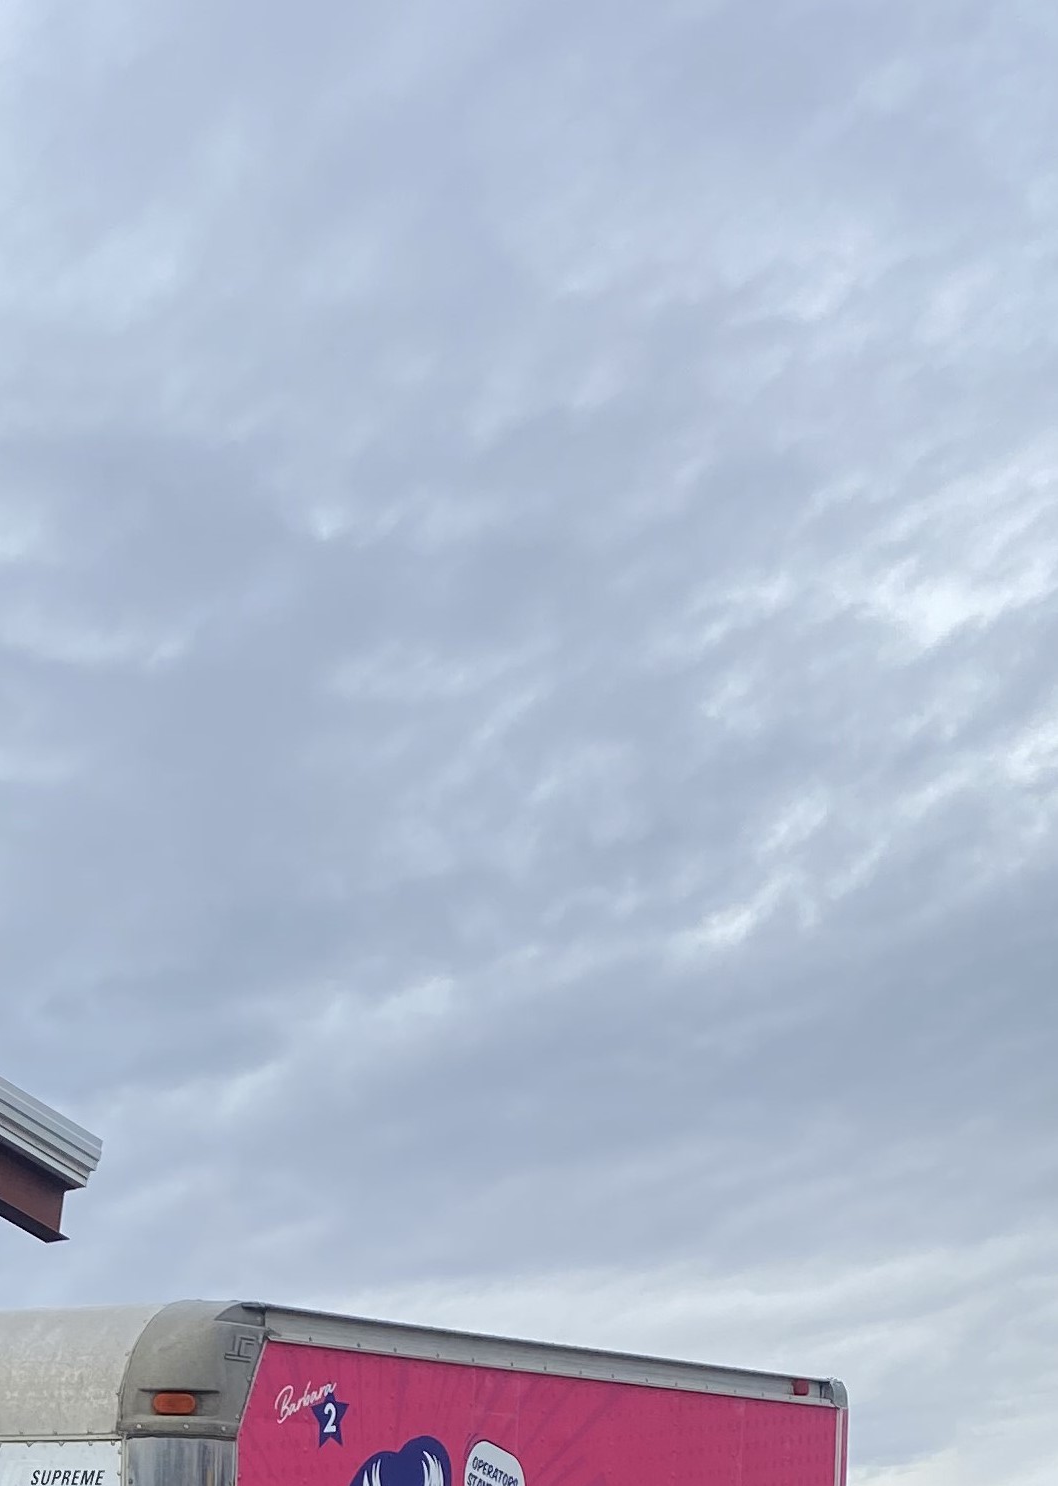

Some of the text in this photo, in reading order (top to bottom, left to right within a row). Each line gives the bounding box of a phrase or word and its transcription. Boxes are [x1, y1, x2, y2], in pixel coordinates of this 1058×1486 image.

[274, 1380, 337, 1424] Barbara
[323, 1402, 337, 1433] 2
[30, 1469, 106, 1486] SUPREME
